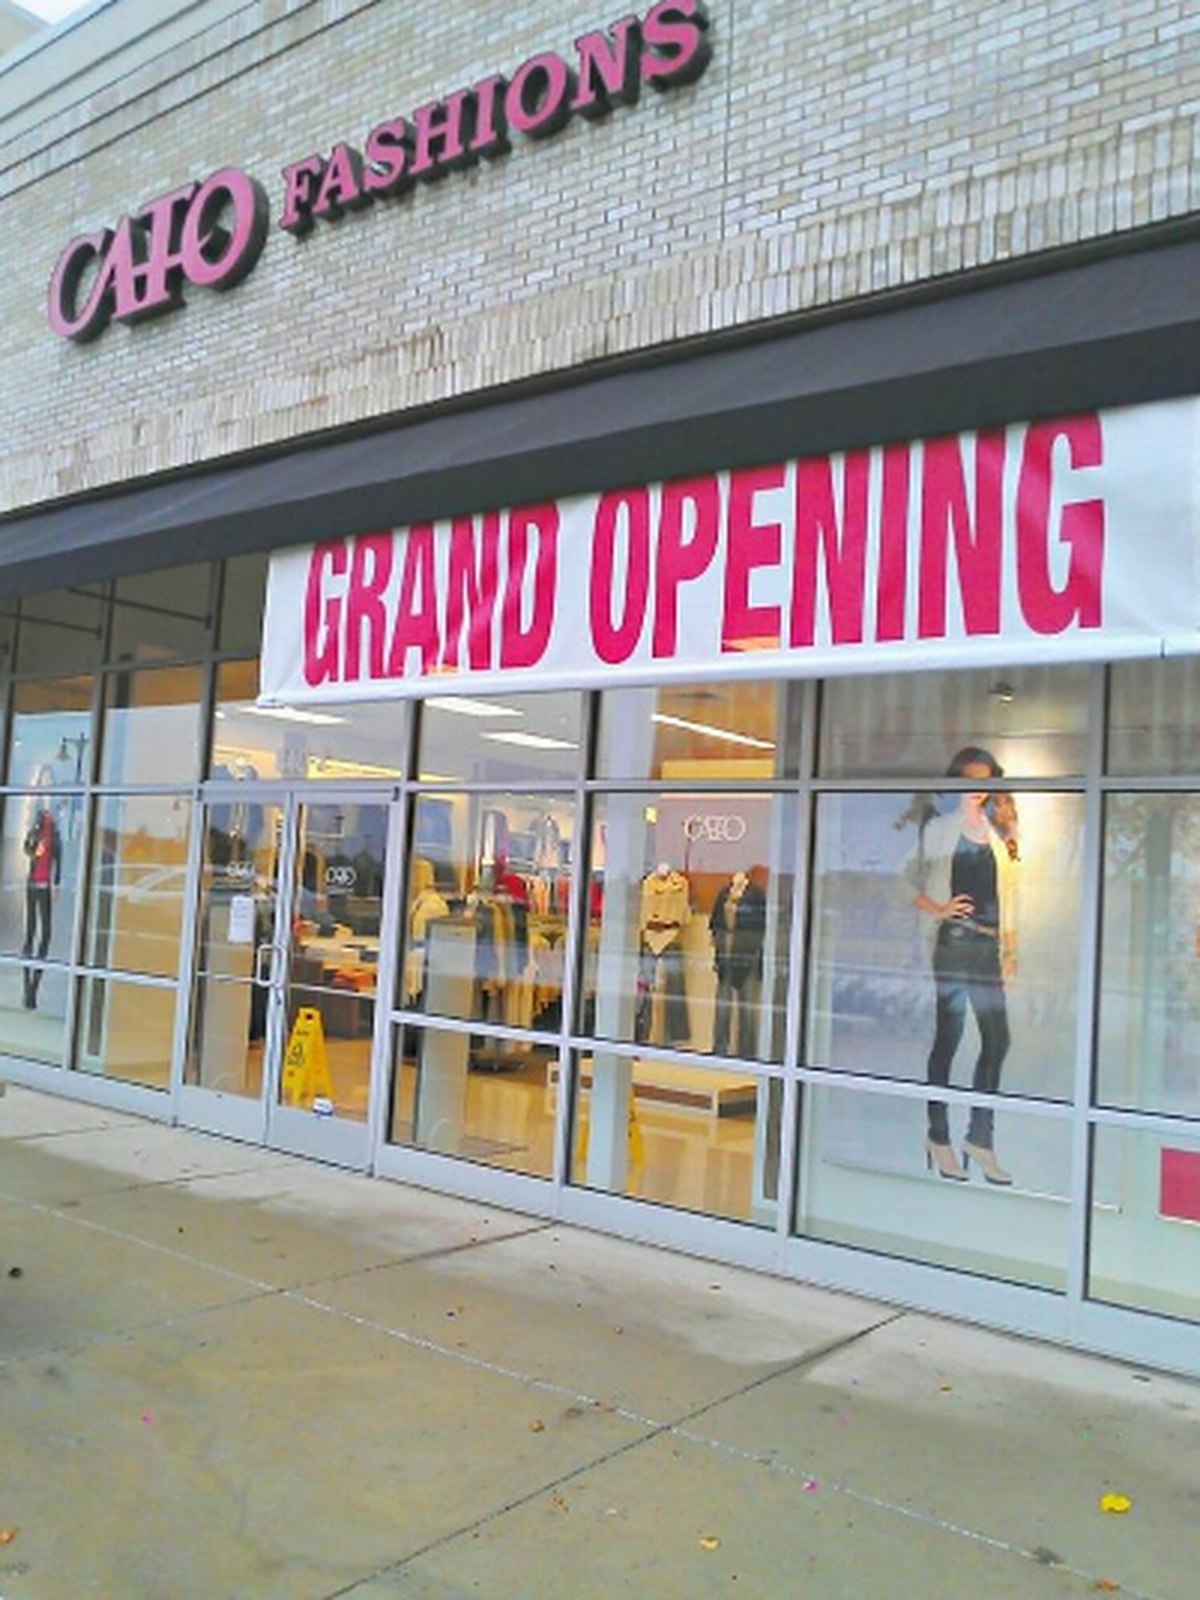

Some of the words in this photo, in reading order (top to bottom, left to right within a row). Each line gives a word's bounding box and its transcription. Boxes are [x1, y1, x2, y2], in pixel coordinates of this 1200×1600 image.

[47, 167, 262, 341] CATO
[279, 0, 706, 232] FASHIONS
[303, 501, 560, 687] GRAND
[589, 415, 1104, 666] OPENING
